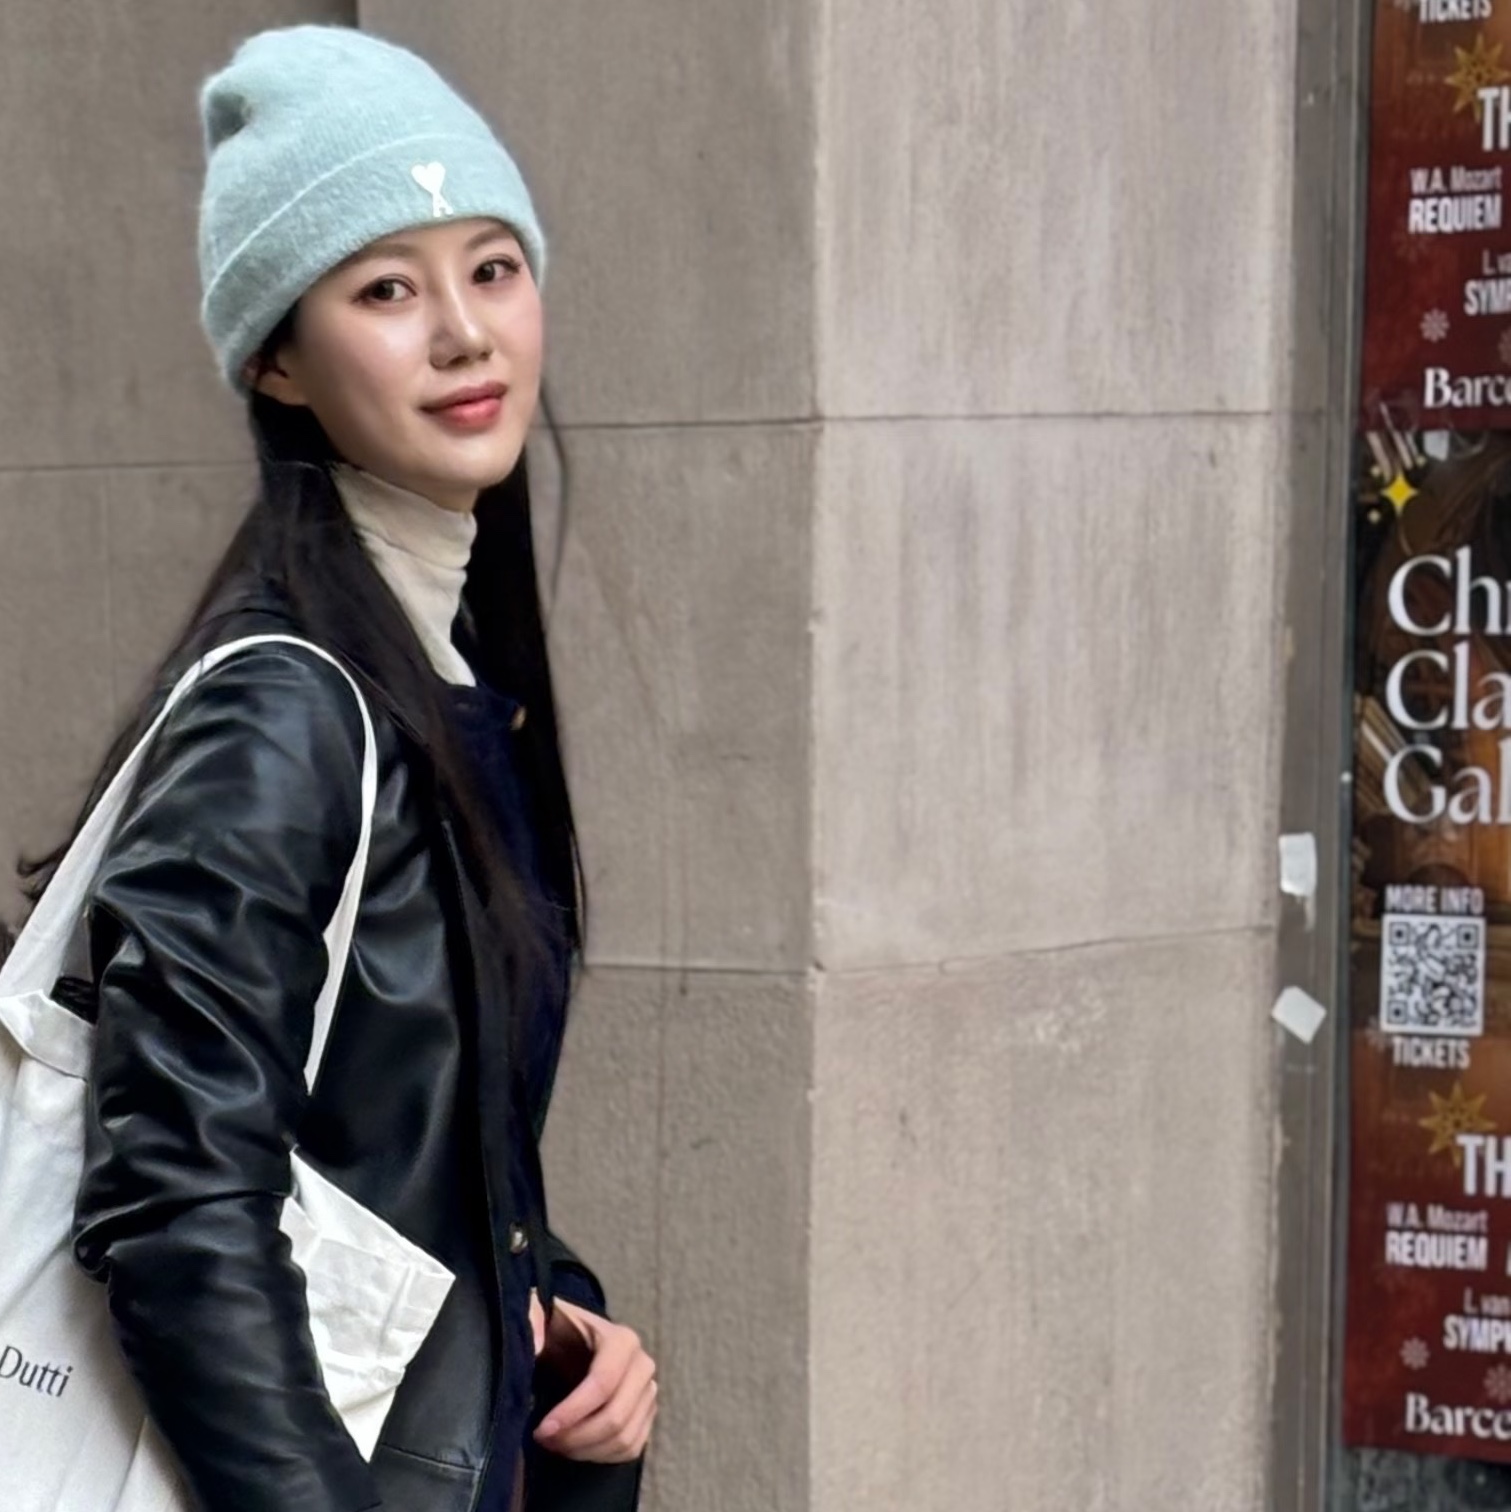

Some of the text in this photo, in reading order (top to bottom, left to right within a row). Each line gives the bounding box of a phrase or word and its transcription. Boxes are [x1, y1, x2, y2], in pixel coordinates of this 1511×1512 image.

[1408, 194, 1502, 233] REQUIEM
[1385, 640, 1511, 731] Cla
[1383, 737, 1511, 825] Gal
[1385, 885, 1485, 915] MORE INFO
[1392, 1034, 1471, 1069] TICKETS
[1385, 1230, 1489, 1271] REQUIEM
